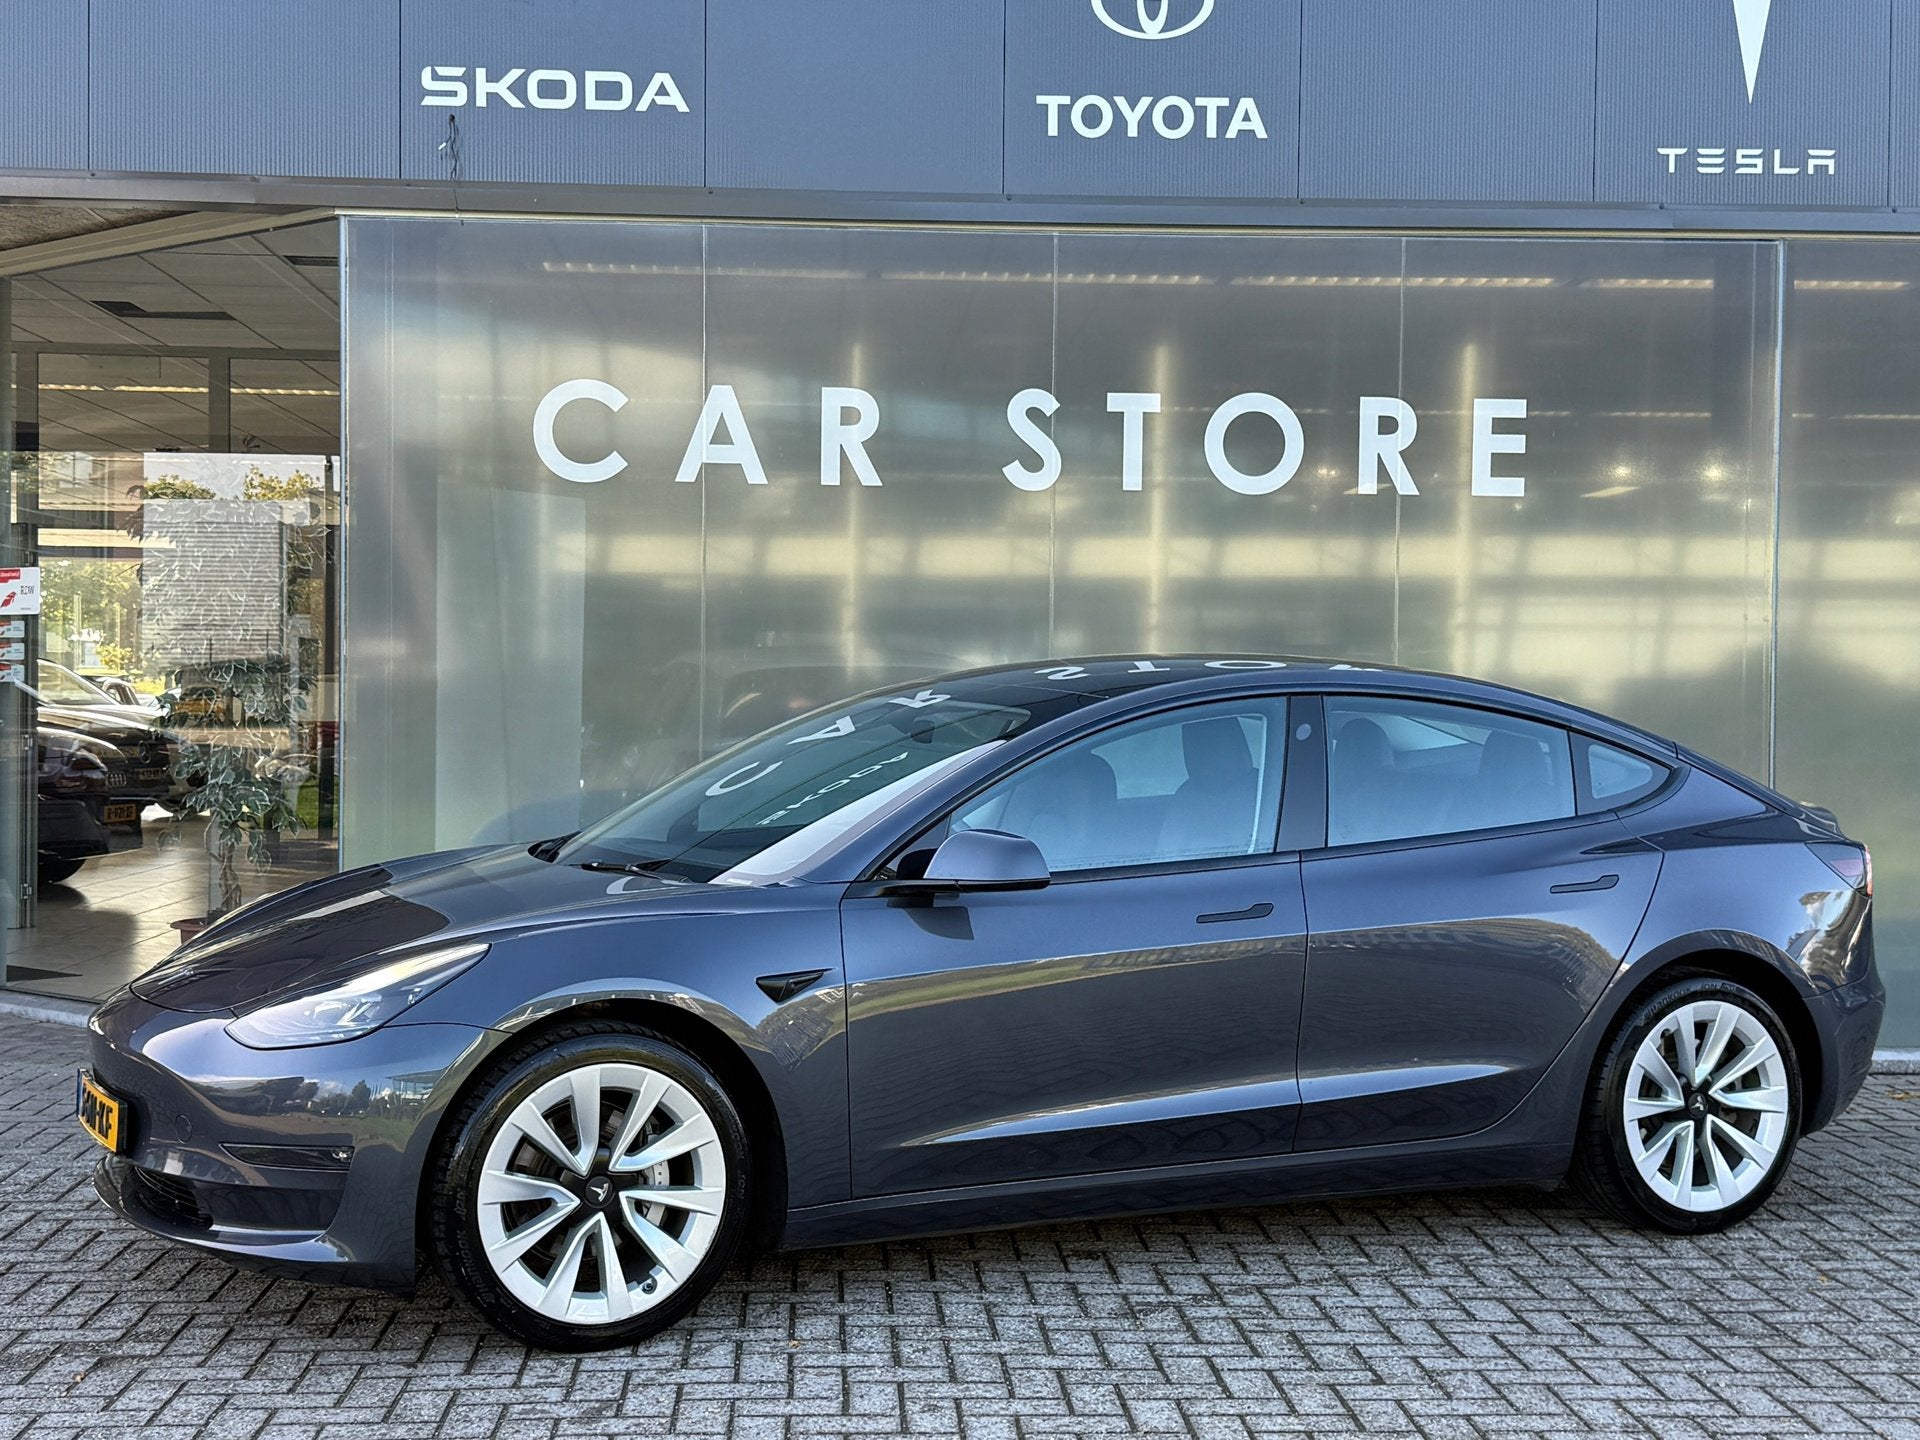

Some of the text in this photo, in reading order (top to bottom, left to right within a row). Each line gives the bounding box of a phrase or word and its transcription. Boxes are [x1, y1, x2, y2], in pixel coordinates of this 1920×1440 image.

[421, 66, 690, 112] SKODA
[1036, 94, 1268, 139] TOYOTA
[1656, 148, 1836, 175] TESLA
[533, 378, 1527, 497] CAR STORE
